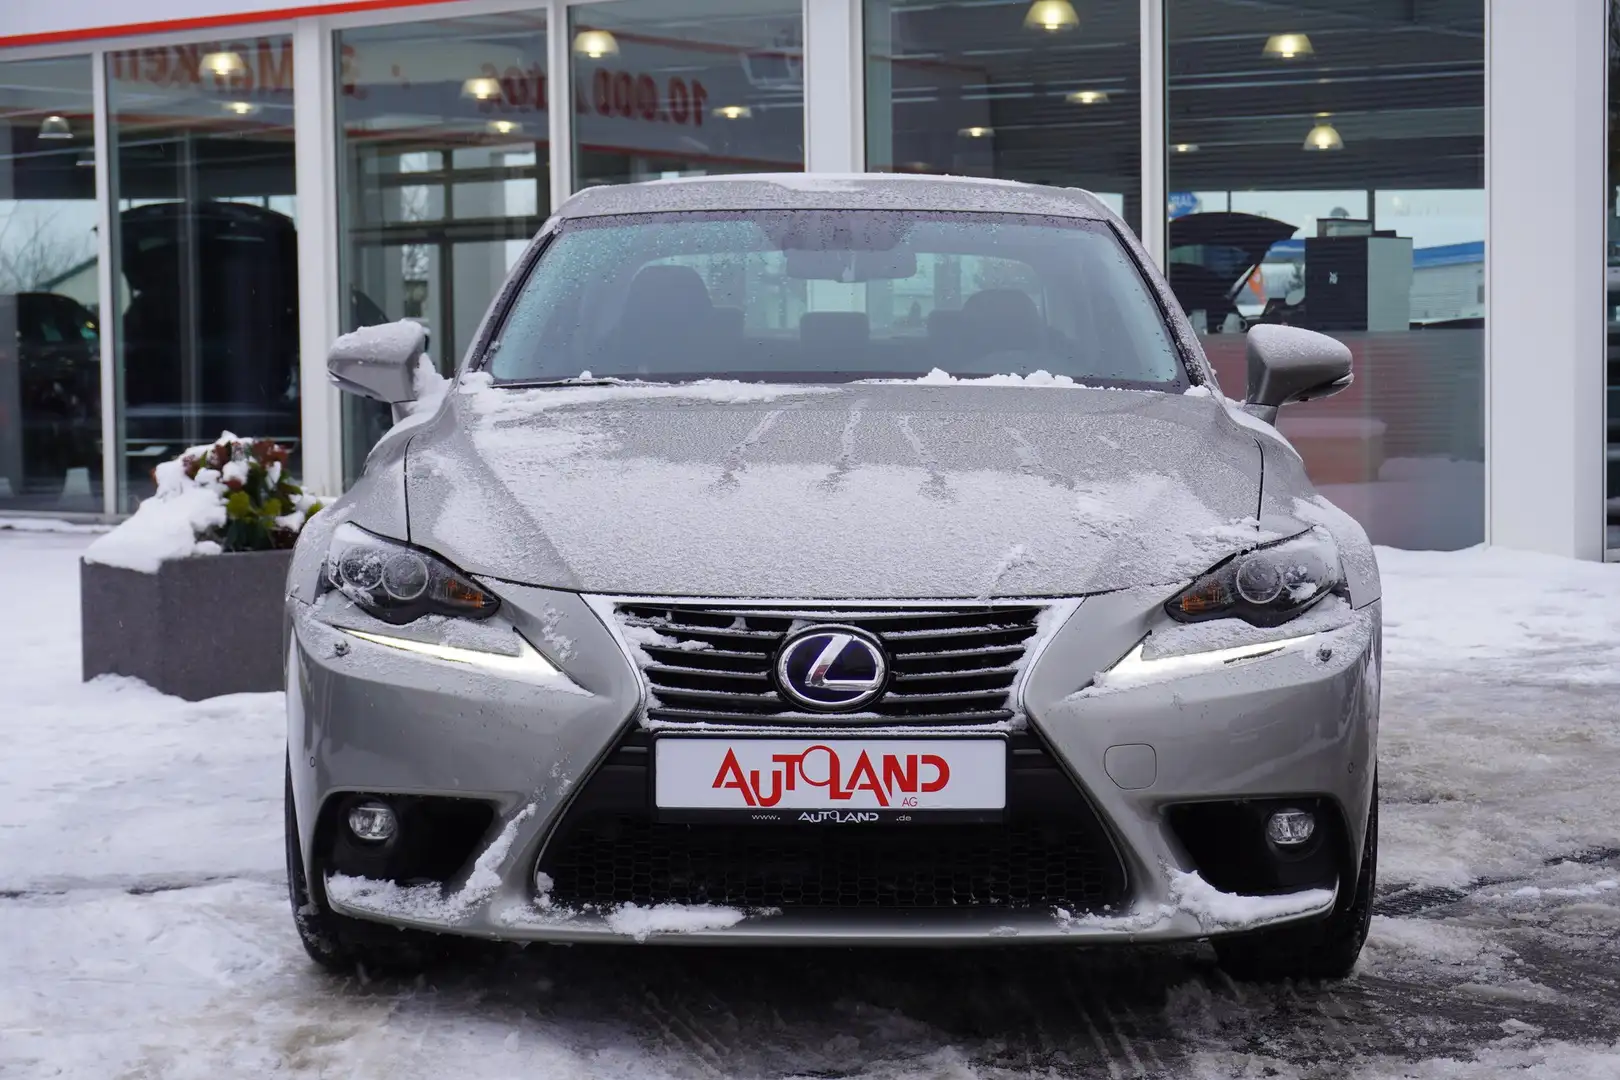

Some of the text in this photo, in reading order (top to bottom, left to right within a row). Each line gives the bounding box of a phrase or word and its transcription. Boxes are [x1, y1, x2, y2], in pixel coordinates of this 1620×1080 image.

[712, 745, 950, 807] AUTOLAND
[902, 797, 918, 807] AG
[798, 810, 880, 823] AUTOLAND
[896, 813, 912, 822] .de
